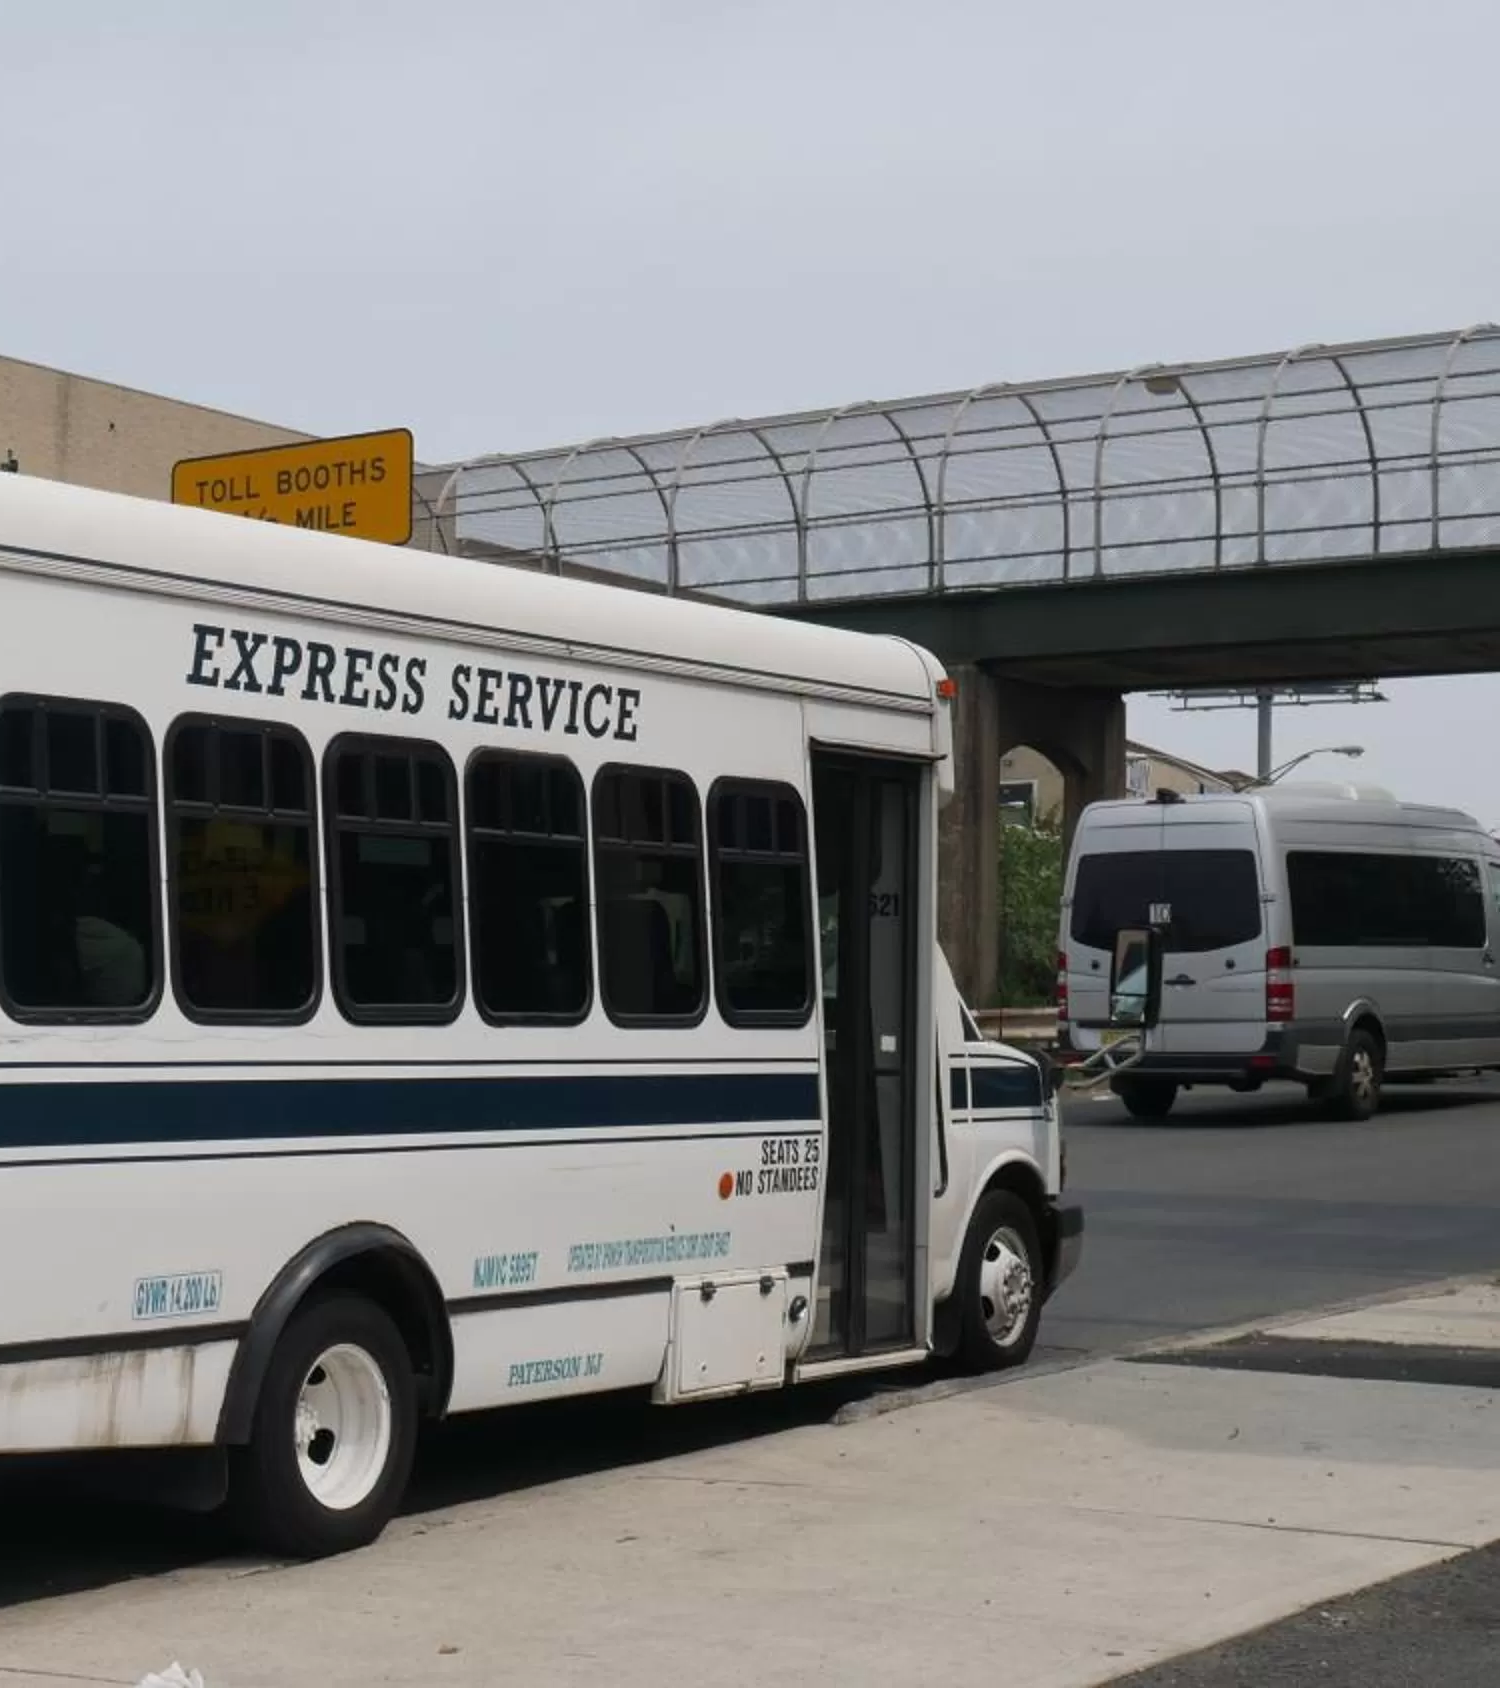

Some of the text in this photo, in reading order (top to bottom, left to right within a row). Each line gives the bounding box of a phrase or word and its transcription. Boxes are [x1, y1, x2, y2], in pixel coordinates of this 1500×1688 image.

[196, 456, 386, 505] TOLL BOOTHS
[295, 501, 357, 530] MILE
[186, 623, 641, 742] EXPRESS SERVICE
[761, 1138, 820, 1165] SEATS 25
[735, 1166, 819, 1196] NO STANDEES
[507, 1355, 583, 1387] PATERSON
